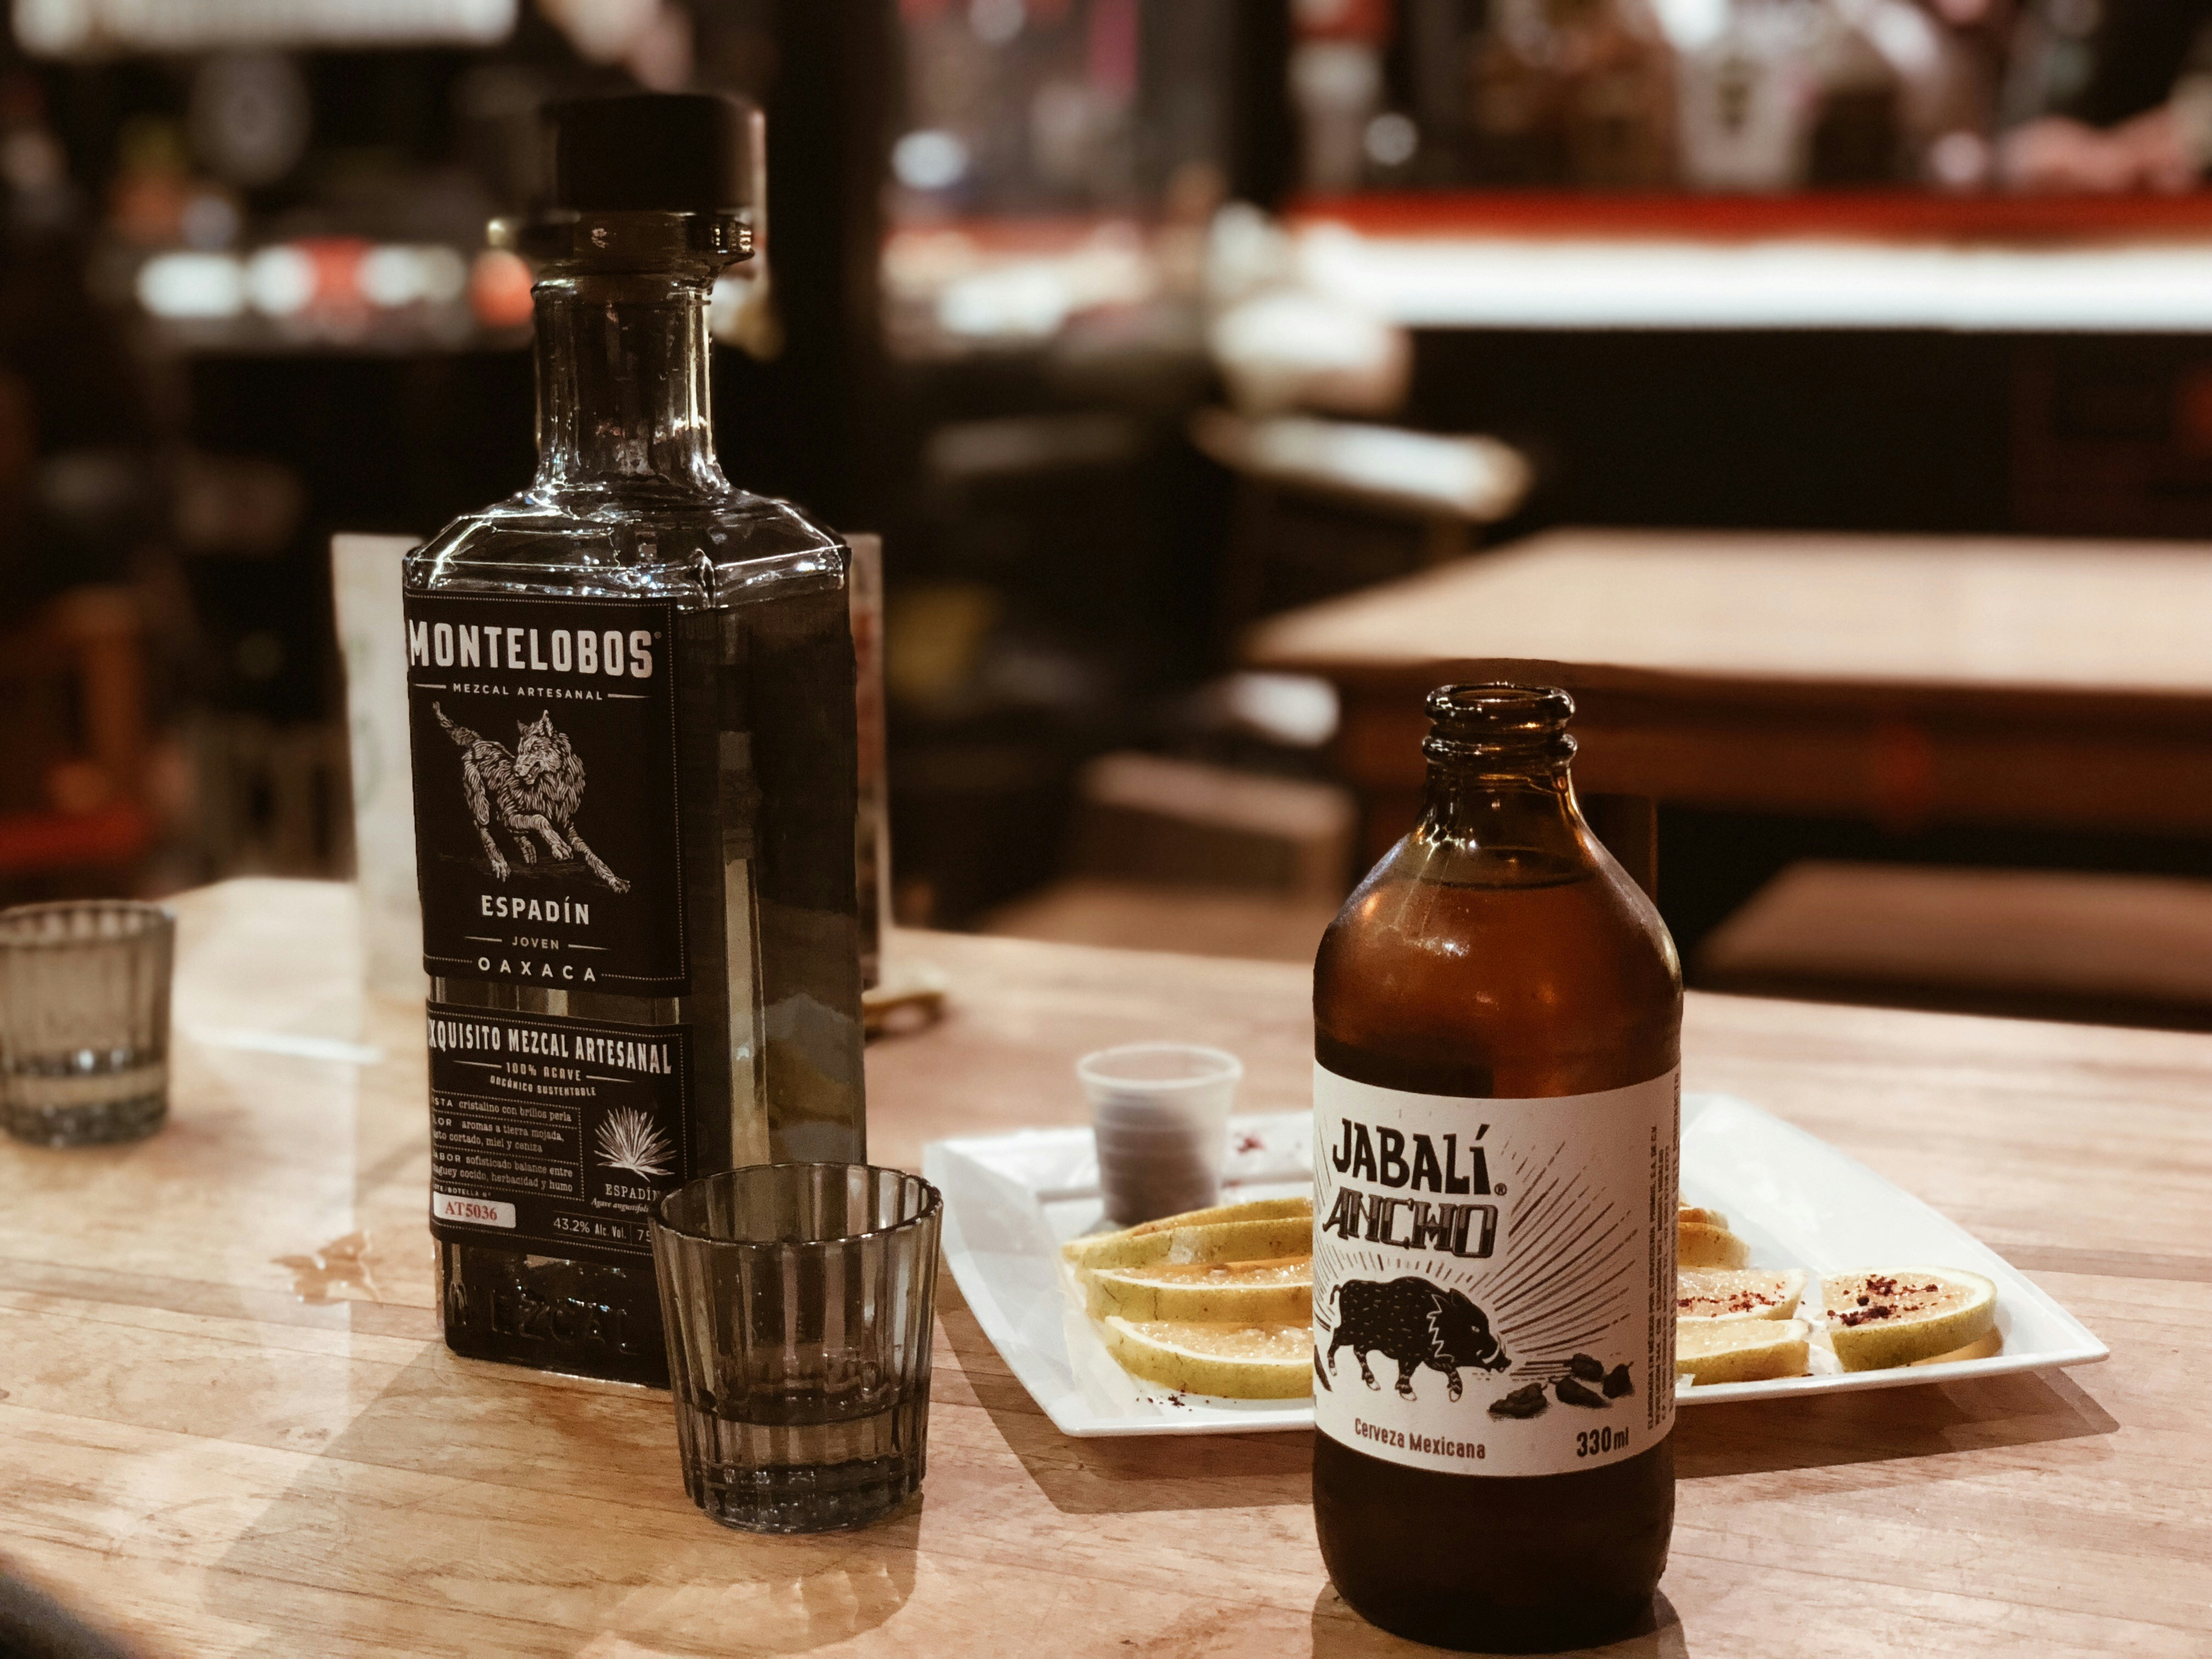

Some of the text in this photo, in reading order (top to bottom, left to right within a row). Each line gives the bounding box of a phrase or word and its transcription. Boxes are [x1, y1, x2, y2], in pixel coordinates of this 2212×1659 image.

[409, 619, 653, 679] MONTELOBOS
[453, 683, 603, 701] MEZCAL ARTESANAL
[481, 895, 589, 925] ESPADÍN
[512, 936, 560, 950] JOVEN
[478, 957, 596, 982] OAXACA
[428, 1018, 672, 1074] XQUISITO MEZCAL ARTESANAL
[506, 1062, 582, 1081] 100% AGAVE
[459, 1099, 500, 1113] cristalino
[502, 1106, 517, 1114] con
[520, 1107, 547, 1119] brillos
[549, 1111, 572, 1122] perla
[449, 1132, 483, 1147] cortado,
[486, 1136, 504, 1147] miel
[506, 1141, 512, 1150] y
[515, 1141, 543, 1153] ceniza
[461, 1120, 493, 1132] aromas
[503, 1125, 528, 1137] tierra
[531, 1128, 565, 1142] mojada,
[433, 1152, 573, 1178] ABOR sofisticado balance entre
[1331, 1117, 1492, 1197] JABALÍ
[433, 1164, 457, 1178] aguey
[492, 1172, 538, 1187] herbacidad
[540, 1180, 546, 1190] y
[549, 1179, 573, 1192] humo
[444, 1201, 498, 1221] AT5036
[1322, 1186, 1499, 1259] ANCHO
[553, 1217, 591, 1233] 43.2%
[1354, 1417, 1487, 1460] Cerveza Mexicana
